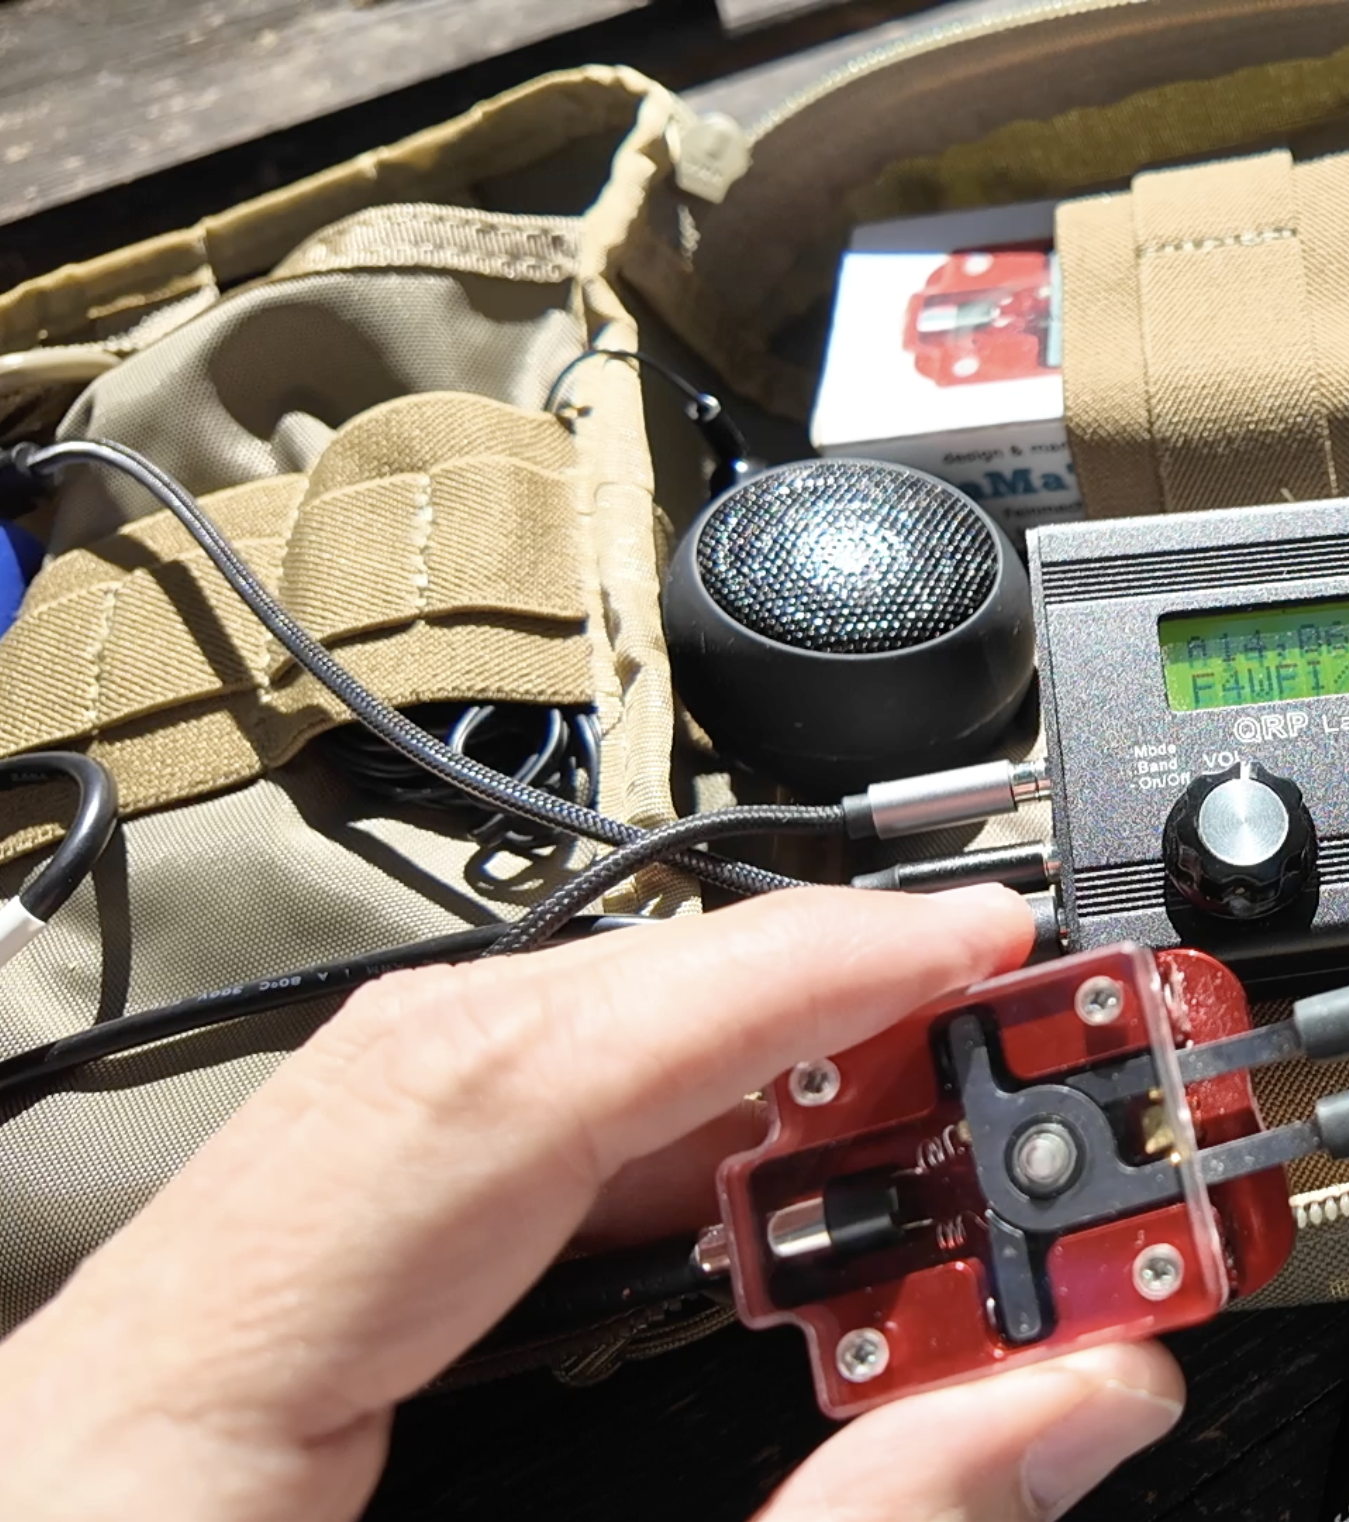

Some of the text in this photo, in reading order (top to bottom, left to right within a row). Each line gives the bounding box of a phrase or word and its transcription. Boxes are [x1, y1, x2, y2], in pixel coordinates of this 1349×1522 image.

[1233, 712, 1309, 742] QRP
[1134, 743, 1177, 758] Mode
[1138, 758, 1178, 774] Band
